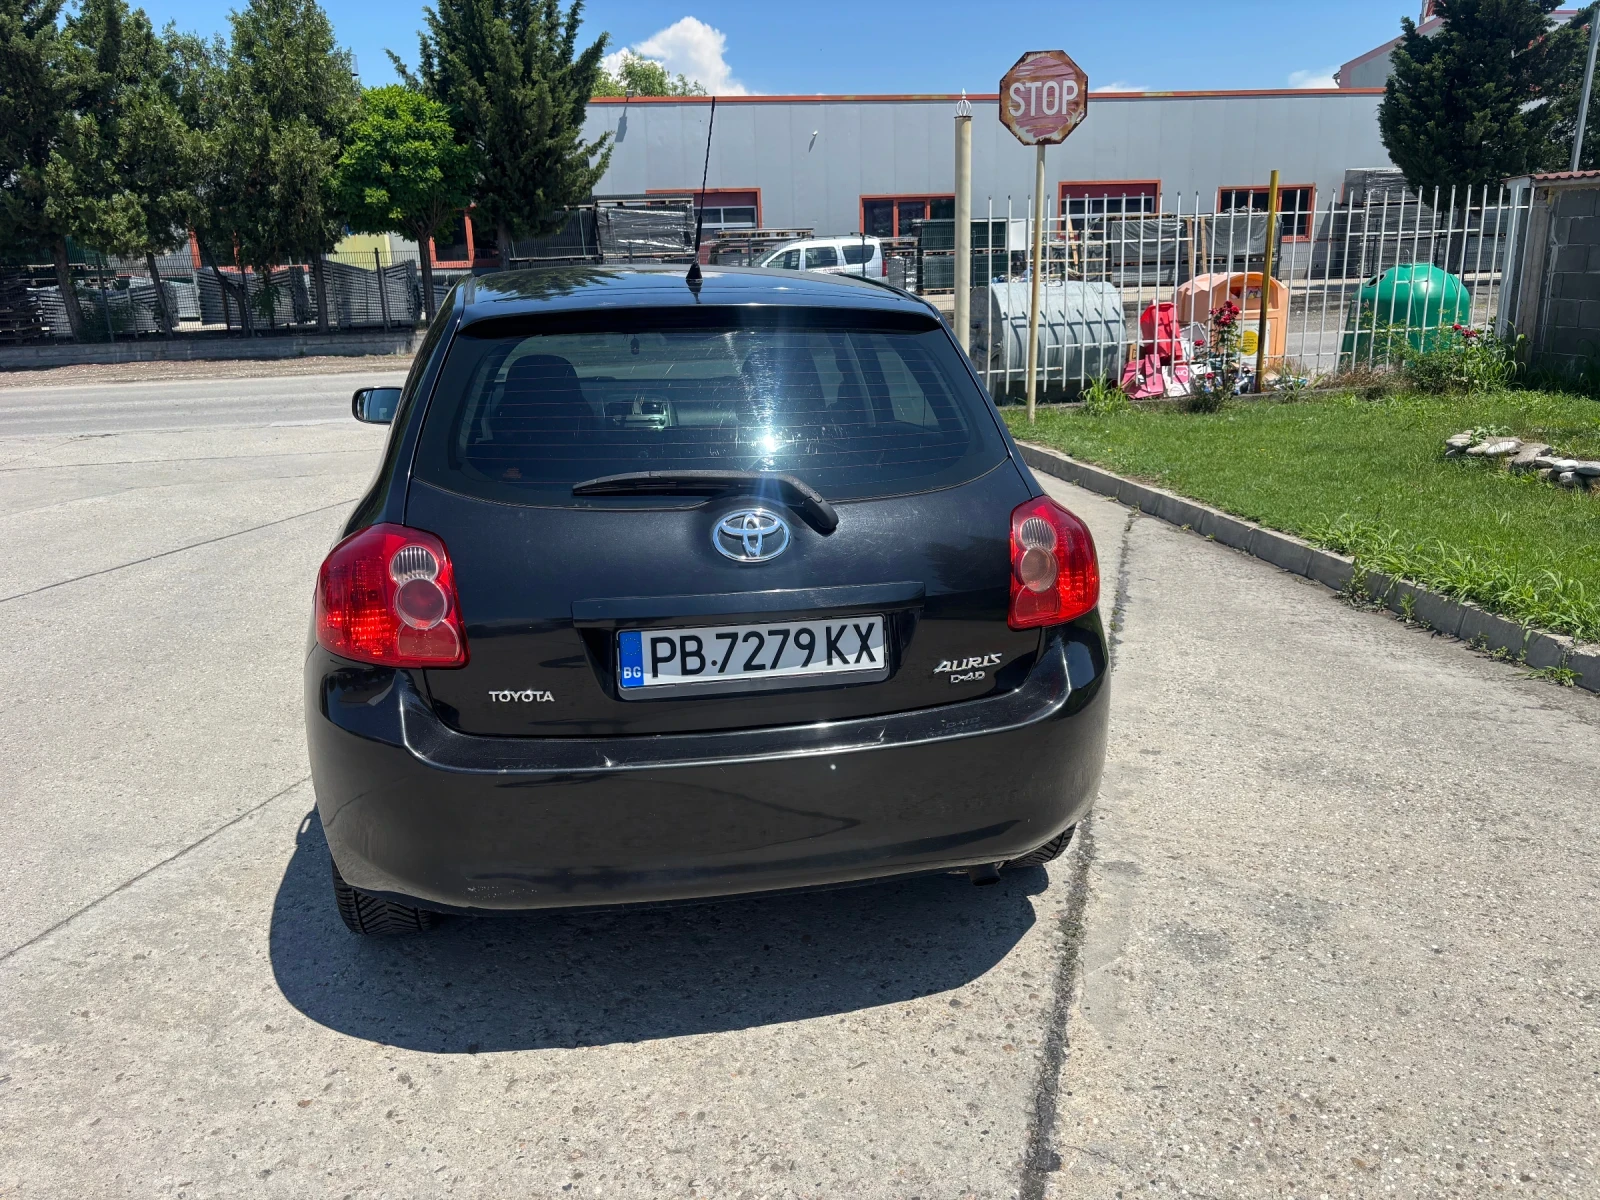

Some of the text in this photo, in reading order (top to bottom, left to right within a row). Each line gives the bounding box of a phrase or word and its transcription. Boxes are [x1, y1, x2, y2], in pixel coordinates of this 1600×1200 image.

[1009, 80, 1079, 117] STOP
[623, 666, 642, 679] BG
[933, 652, 1003, 675] AURIS
[488, 689, 556, 702] TOYOTA
